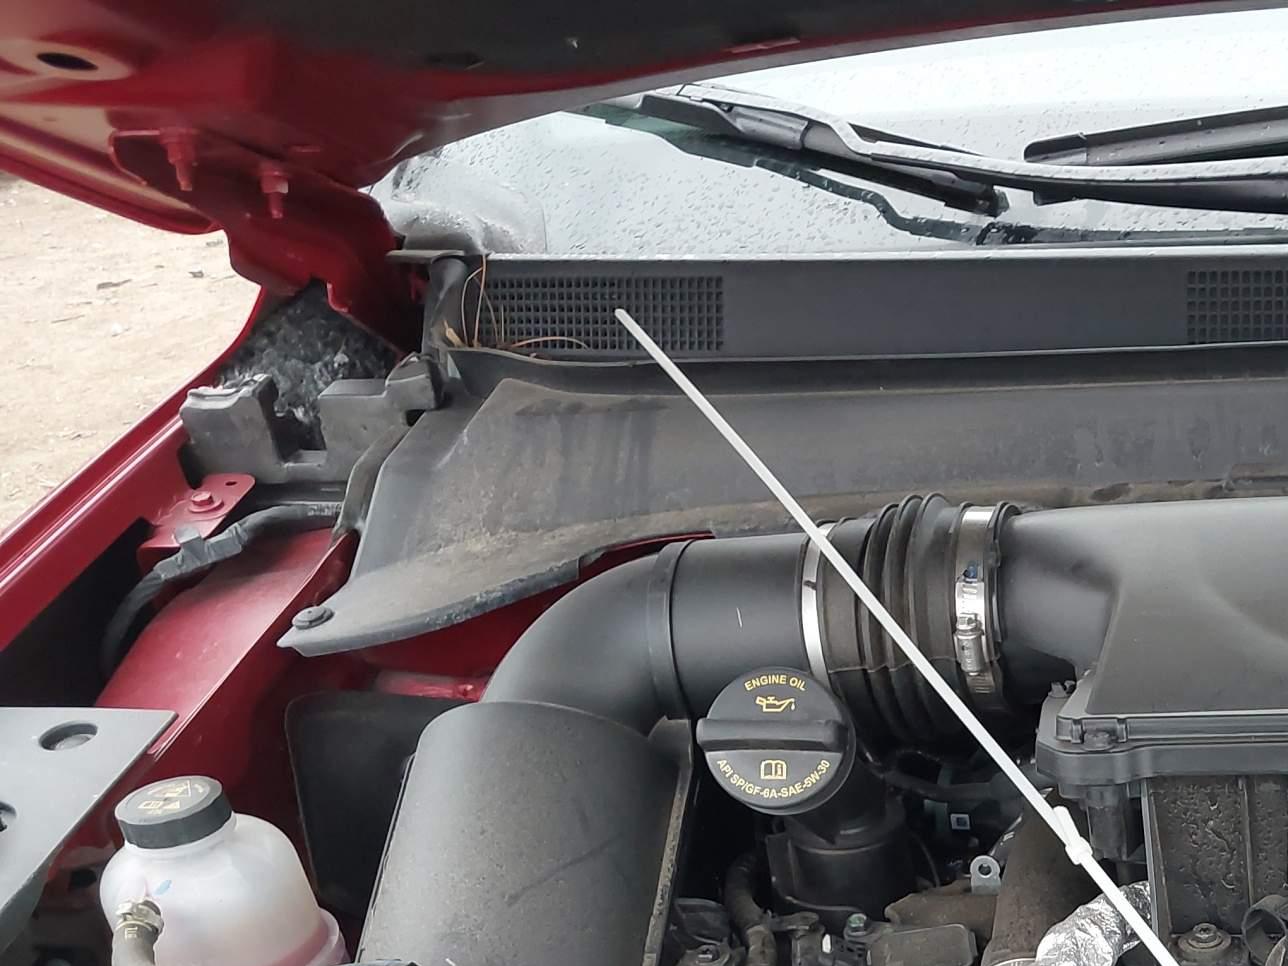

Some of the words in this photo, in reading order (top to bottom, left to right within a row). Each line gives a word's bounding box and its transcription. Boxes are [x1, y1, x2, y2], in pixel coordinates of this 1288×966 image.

[744, 674, 787, 691] ENGINE
[789, 677, 807, 692] OIL
[717, 759, 734, 778] API
